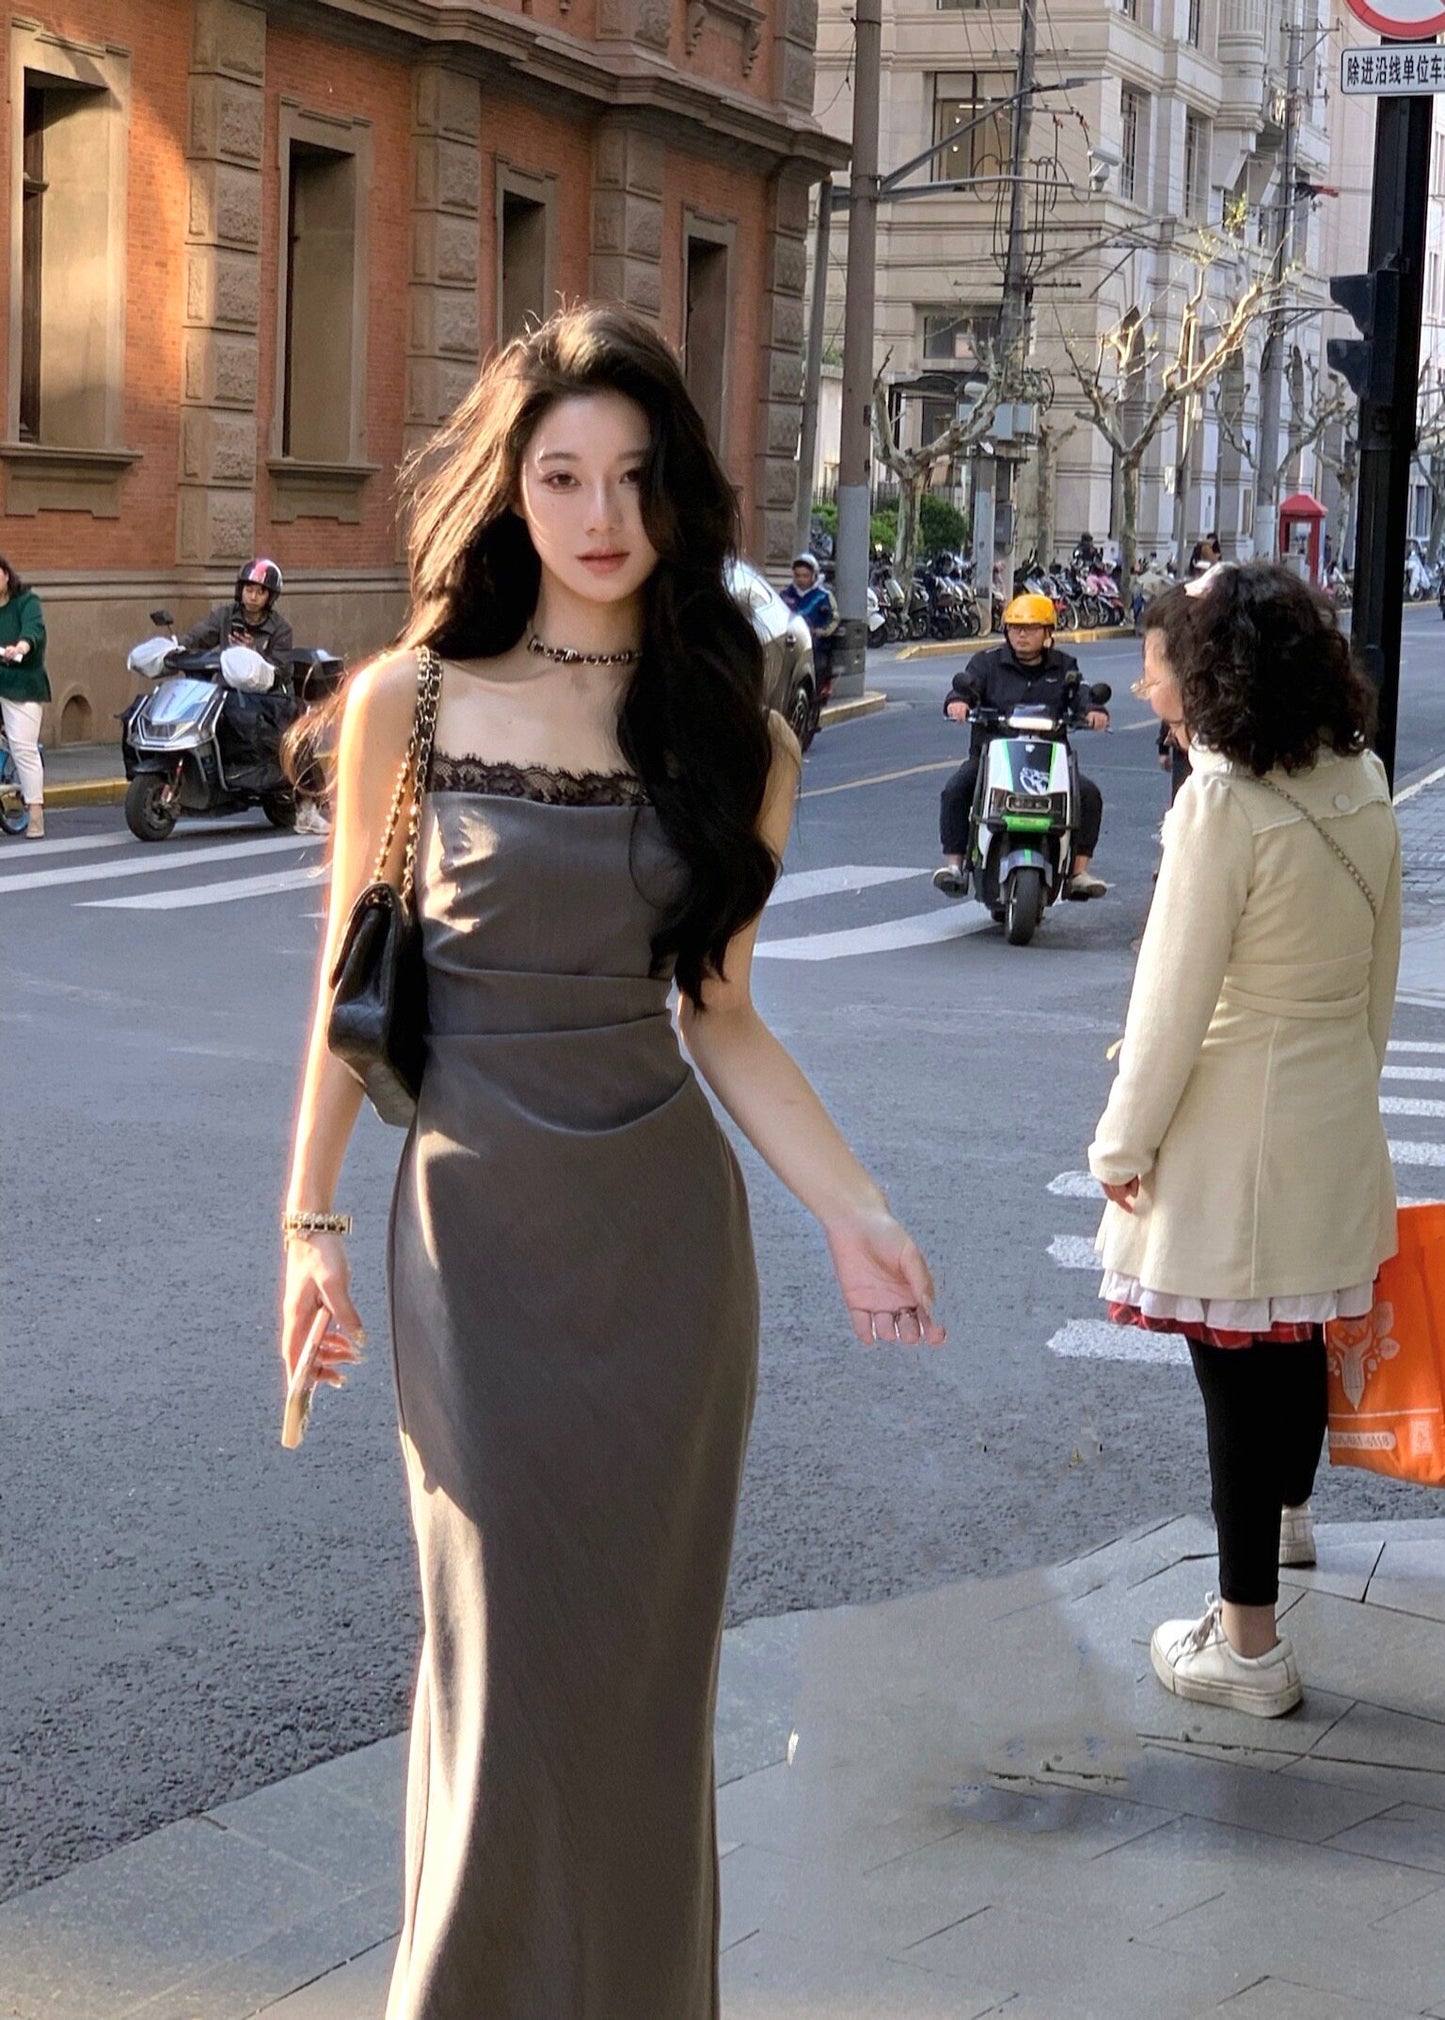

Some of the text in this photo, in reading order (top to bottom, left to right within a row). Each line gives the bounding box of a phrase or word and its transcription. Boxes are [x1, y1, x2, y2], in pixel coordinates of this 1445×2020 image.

[1347, 54, 1445, 86] 除进沿线单位车
